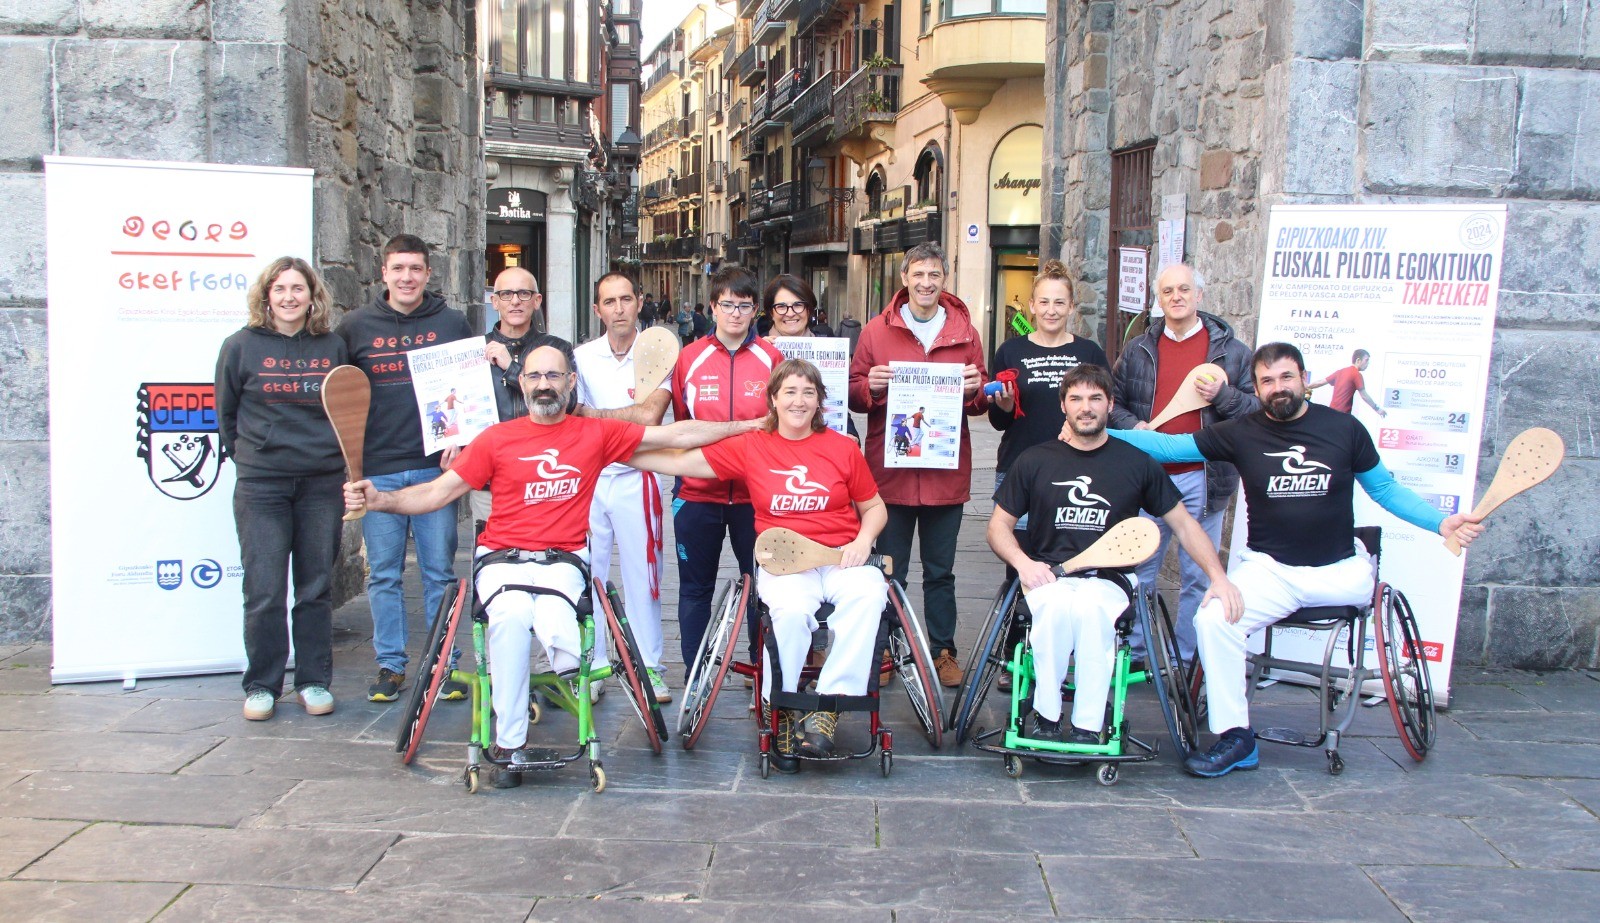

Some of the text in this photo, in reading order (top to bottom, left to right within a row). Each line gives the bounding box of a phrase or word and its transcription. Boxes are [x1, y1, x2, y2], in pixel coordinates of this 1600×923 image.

[994, 172, 1041, 196] Arangu
[1276, 226, 1388, 250] GIPUZKOAKO XIV.
[1467, 224, 1492, 240] 2024
[1272, 250, 1493, 282] EUSKAL PILOTA EGOKITUKO
[1402, 282, 1490, 306] TXAPELKETA
[1291, 309, 1339, 318] FINALA
[797, 351, 815, 360] PILOTA
[816, 351, 846, 361] EGOKITUKO
[1415, 368, 1447, 378] 10:00
[912, 376, 931, 384] PILOTA
[931, 376, 961, 386] EGOKITUKO
[1392, 390, 1400, 400] 3
[1448, 413, 1466, 424] 24
[1382, 429, 1400, 441] 23
[1445, 455, 1459, 465] 13
[524, 478, 581, 500] KEMEN
[1267, 474, 1331, 492] KEMEN
[770, 494, 830, 511] KEMEN
[1440, 496, 1454, 507] 18
[1054, 507, 1110, 525] KEMEN
